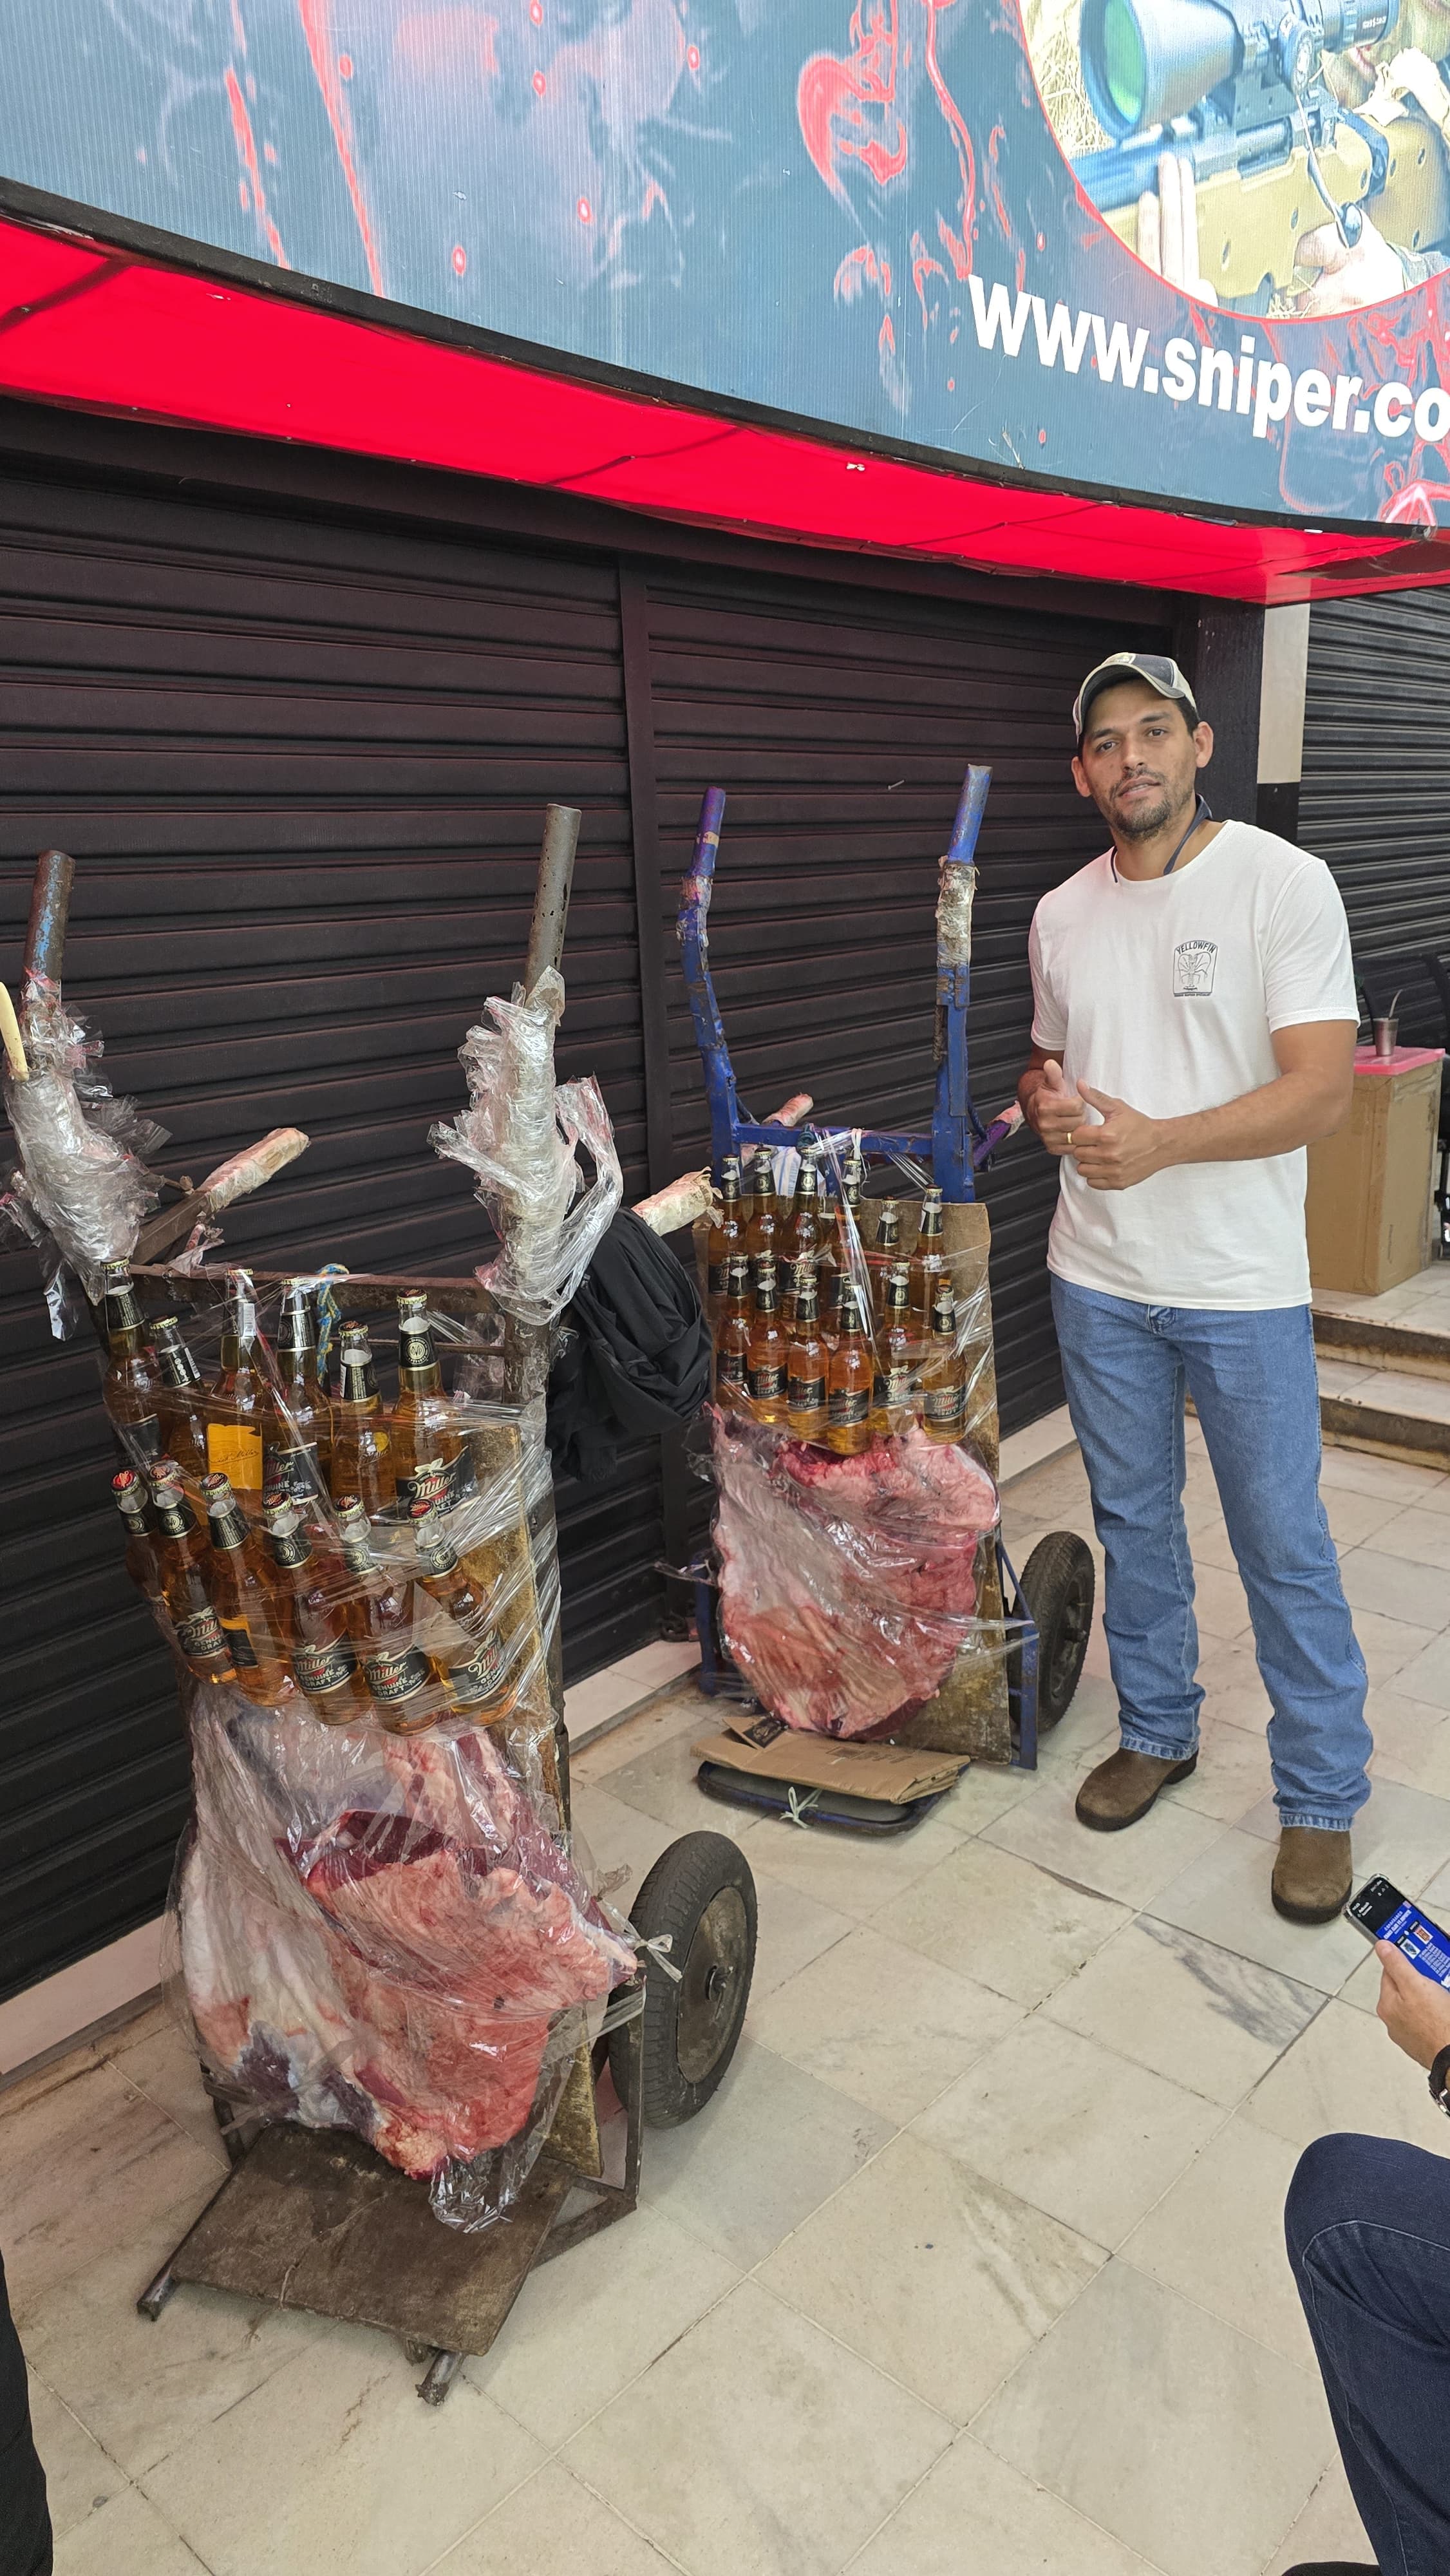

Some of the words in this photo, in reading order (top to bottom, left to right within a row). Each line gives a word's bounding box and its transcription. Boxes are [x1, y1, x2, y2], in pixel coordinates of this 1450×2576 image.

[1176, 942, 1216, 954] YELLOWFIN
[408, 1472, 456, 1499] Miller
[366, 1662, 408, 1681] Miller
